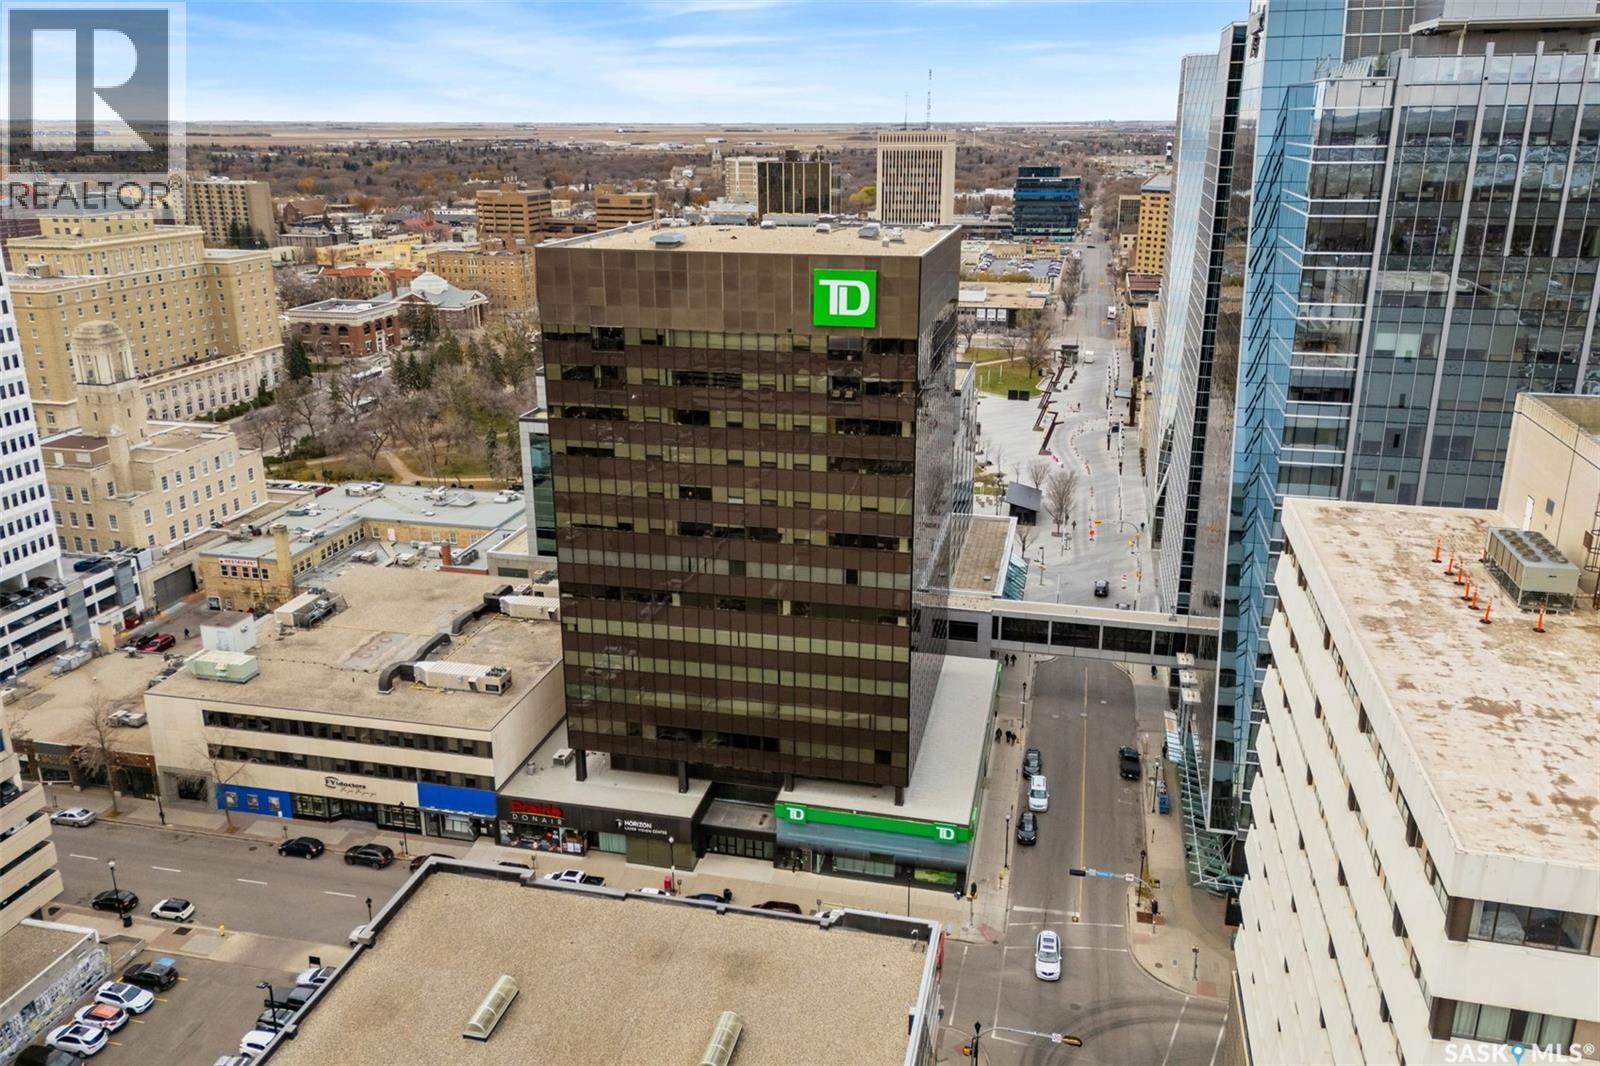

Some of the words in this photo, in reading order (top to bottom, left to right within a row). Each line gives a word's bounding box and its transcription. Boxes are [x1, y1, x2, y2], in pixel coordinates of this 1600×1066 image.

[819, 279, 870, 316] TD
[512, 813, 562, 825] DONAIR
[786, 807, 804, 820] TD
[624, 820, 652, 829] HORIZON
[936, 826, 954, 840] TD
